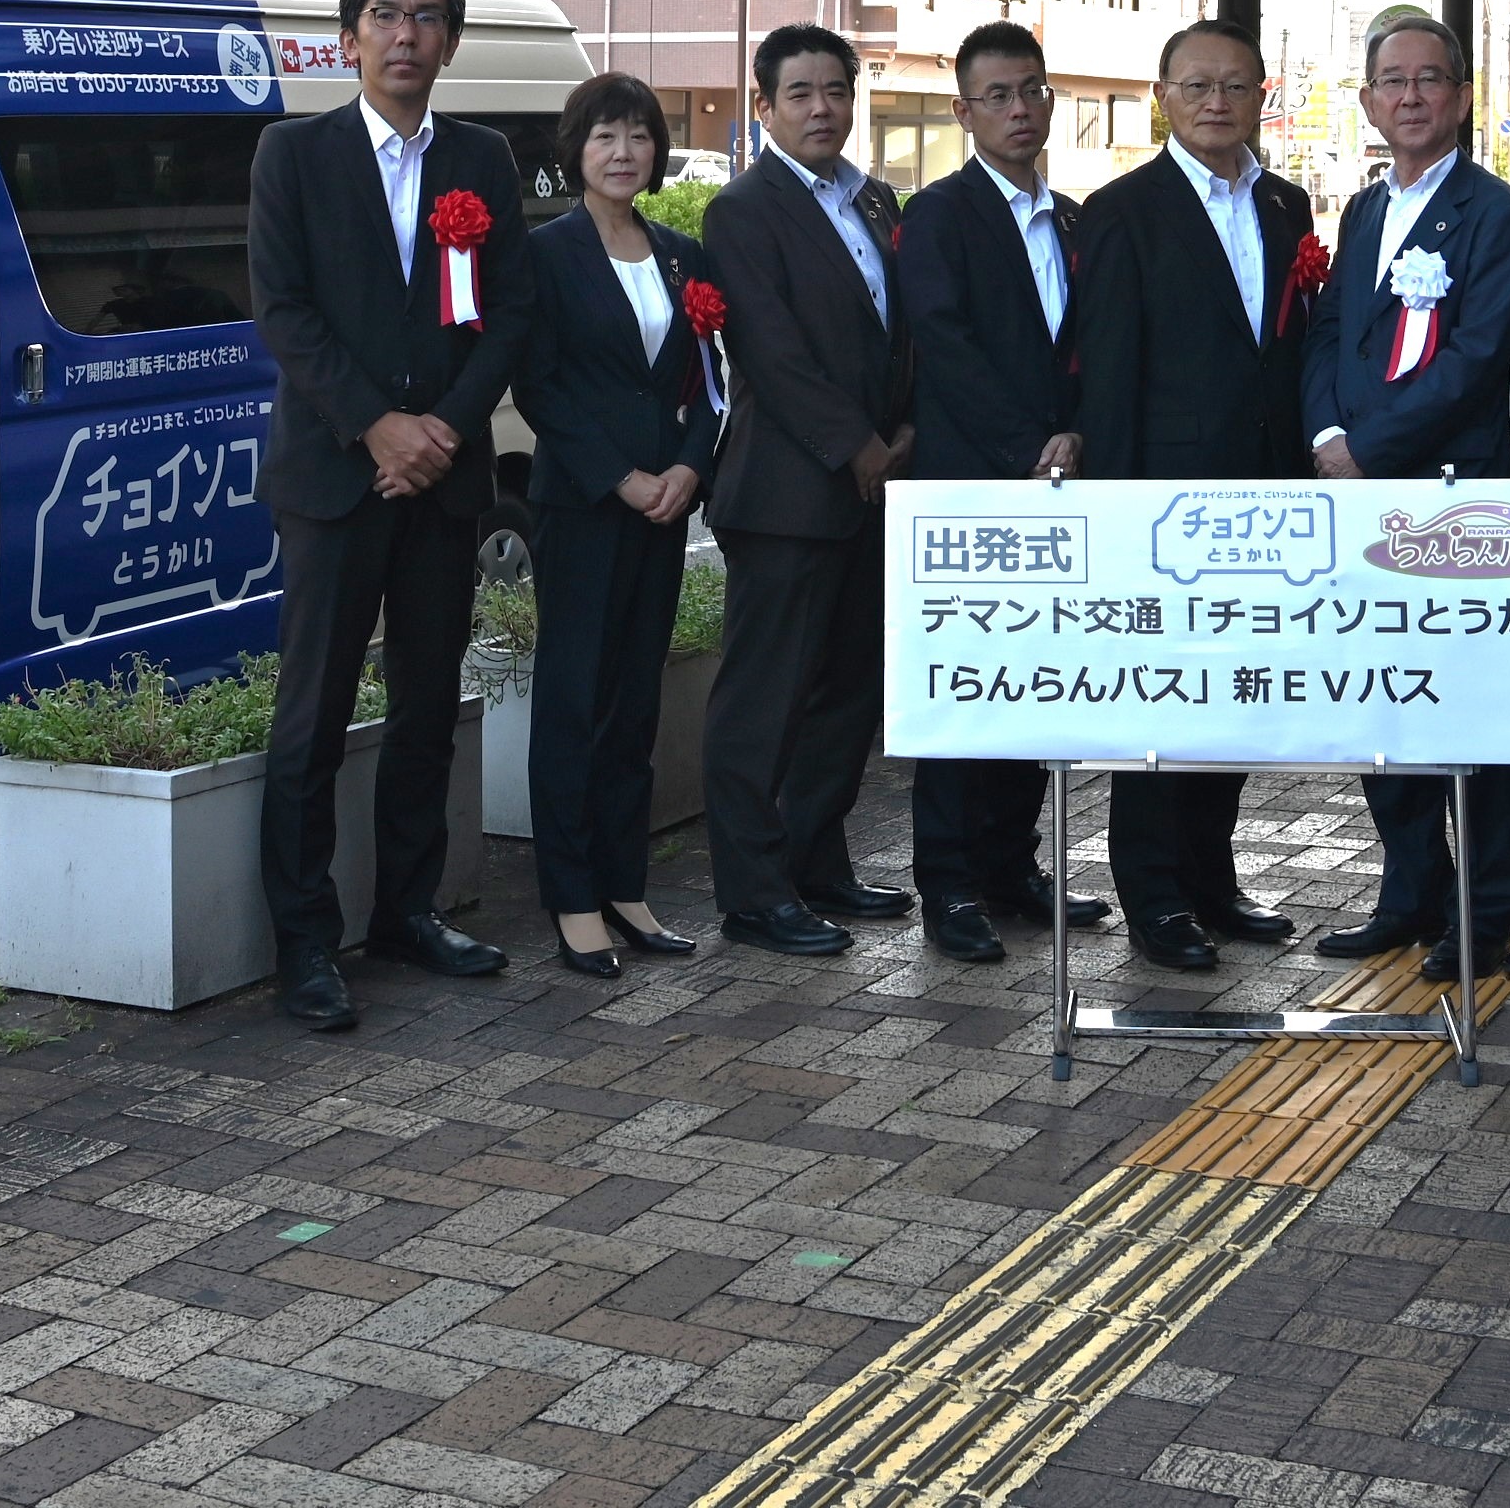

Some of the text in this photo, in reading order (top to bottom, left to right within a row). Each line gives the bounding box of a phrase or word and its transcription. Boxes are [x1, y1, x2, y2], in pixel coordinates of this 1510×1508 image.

[21, 28, 190, 59] 乗り合い送迎サービス
[230, 34, 261, 73] 区域
[6, 71, 220, 94] お問合せ 050-2030-4333
[64, 344, 249, 386] ドア開閉は運転手にお任せください
[94, 401, 255, 441] チョイとソコまで、ごいっしょに
[81, 437, 259, 538] チョイソコ
[1182, 505, 1315, 540] チョイソコ
[113, 537, 213, 585] とうかい
[924, 526, 1072, 573] 出発式
[1207, 547, 1282, 563] とうかい
